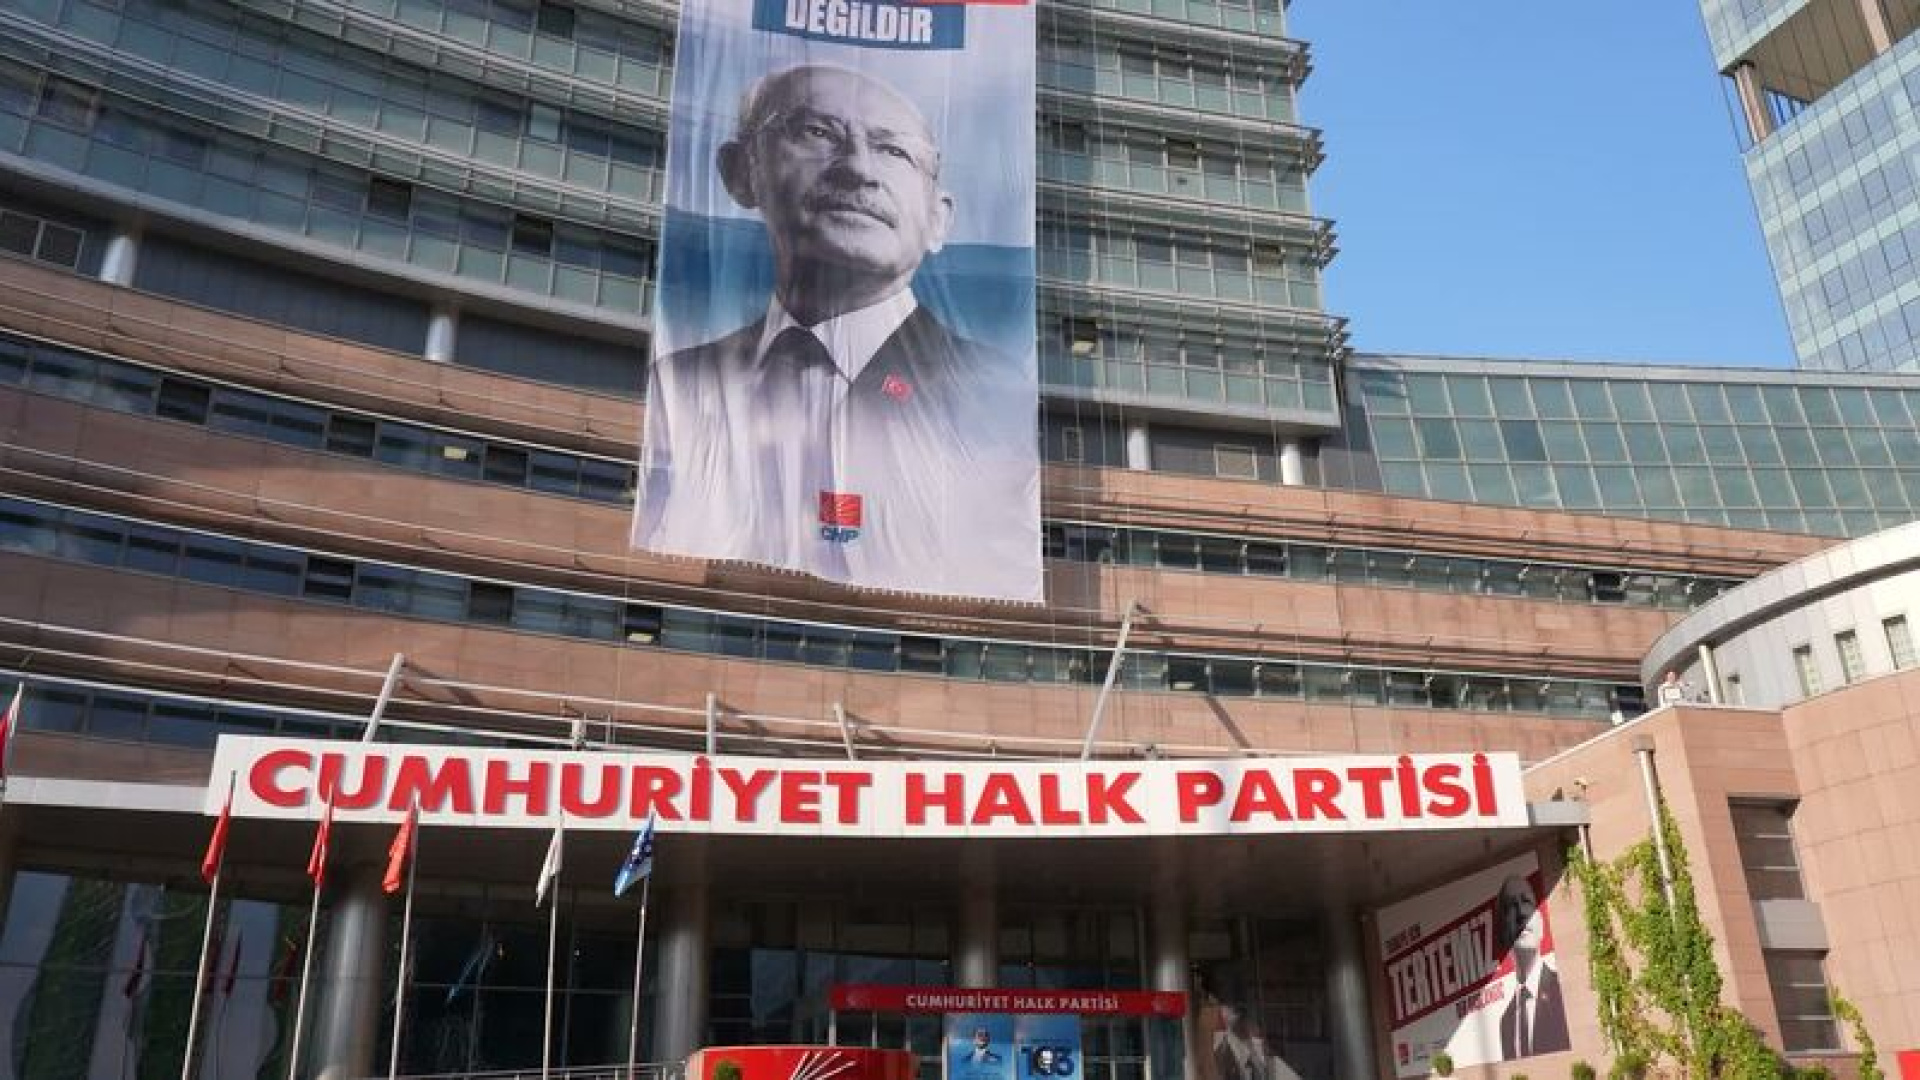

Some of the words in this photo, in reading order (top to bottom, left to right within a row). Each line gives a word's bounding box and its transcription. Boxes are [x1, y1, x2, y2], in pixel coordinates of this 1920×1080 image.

[821, 527, 859, 542] CHP
[248, 749, 872, 824] CUMHURİYET
[904, 772, 1147, 825] HALK
[1176, 754, 1499, 822] PARTİSİ
[1388, 909, 1499, 1021] TERTEMİZ
[905, 991, 1009, 1010] CUMHURİYET
[1013, 995, 1055, 1010] HALK
[1059, 992, 1119, 1011] PARTİSİ
